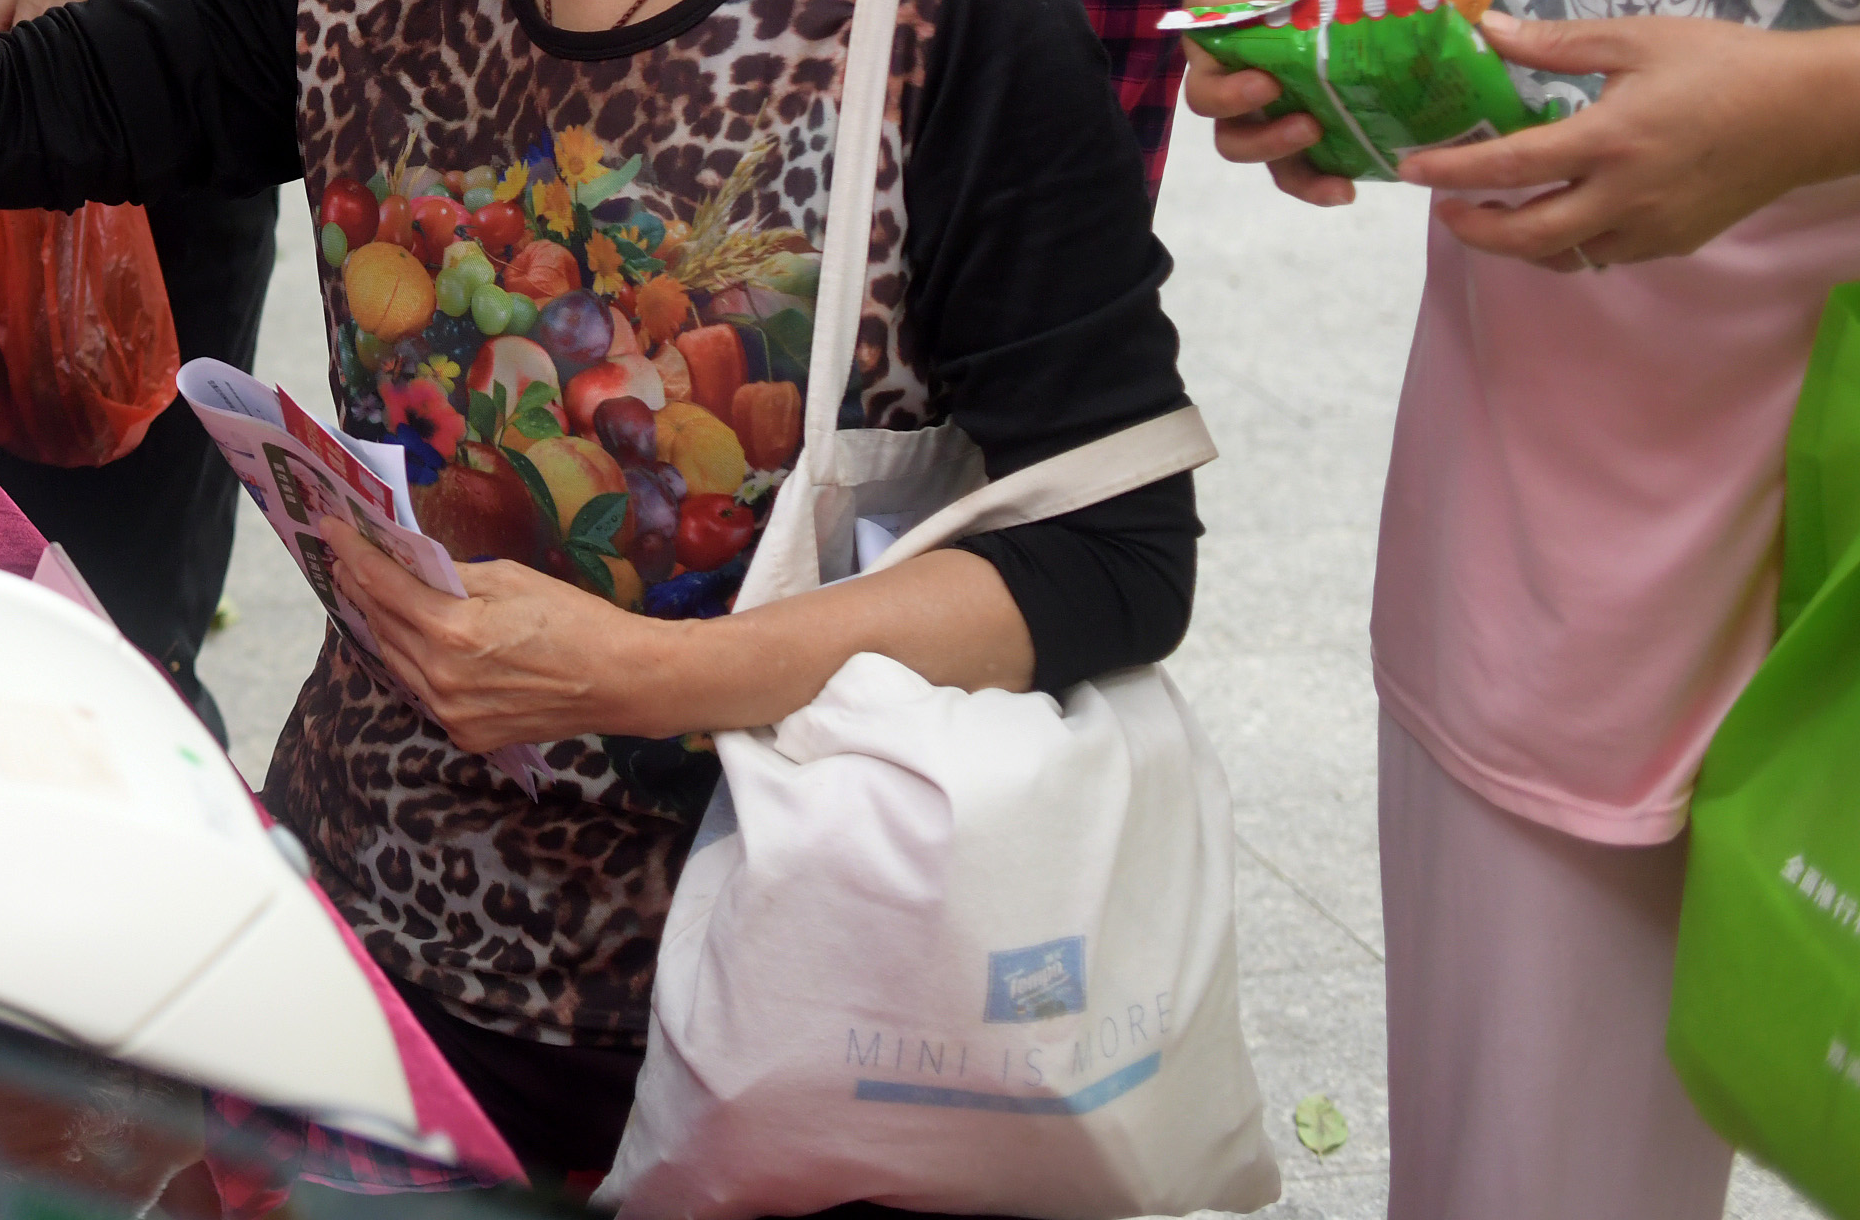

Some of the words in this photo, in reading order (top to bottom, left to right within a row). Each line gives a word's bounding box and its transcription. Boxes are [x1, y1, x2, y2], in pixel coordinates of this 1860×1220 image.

[846, 1027, 968, 1078] MINI
[1002, 1048, 1043, 1087] IS
[1071, 990, 1174, 1078] MORE
